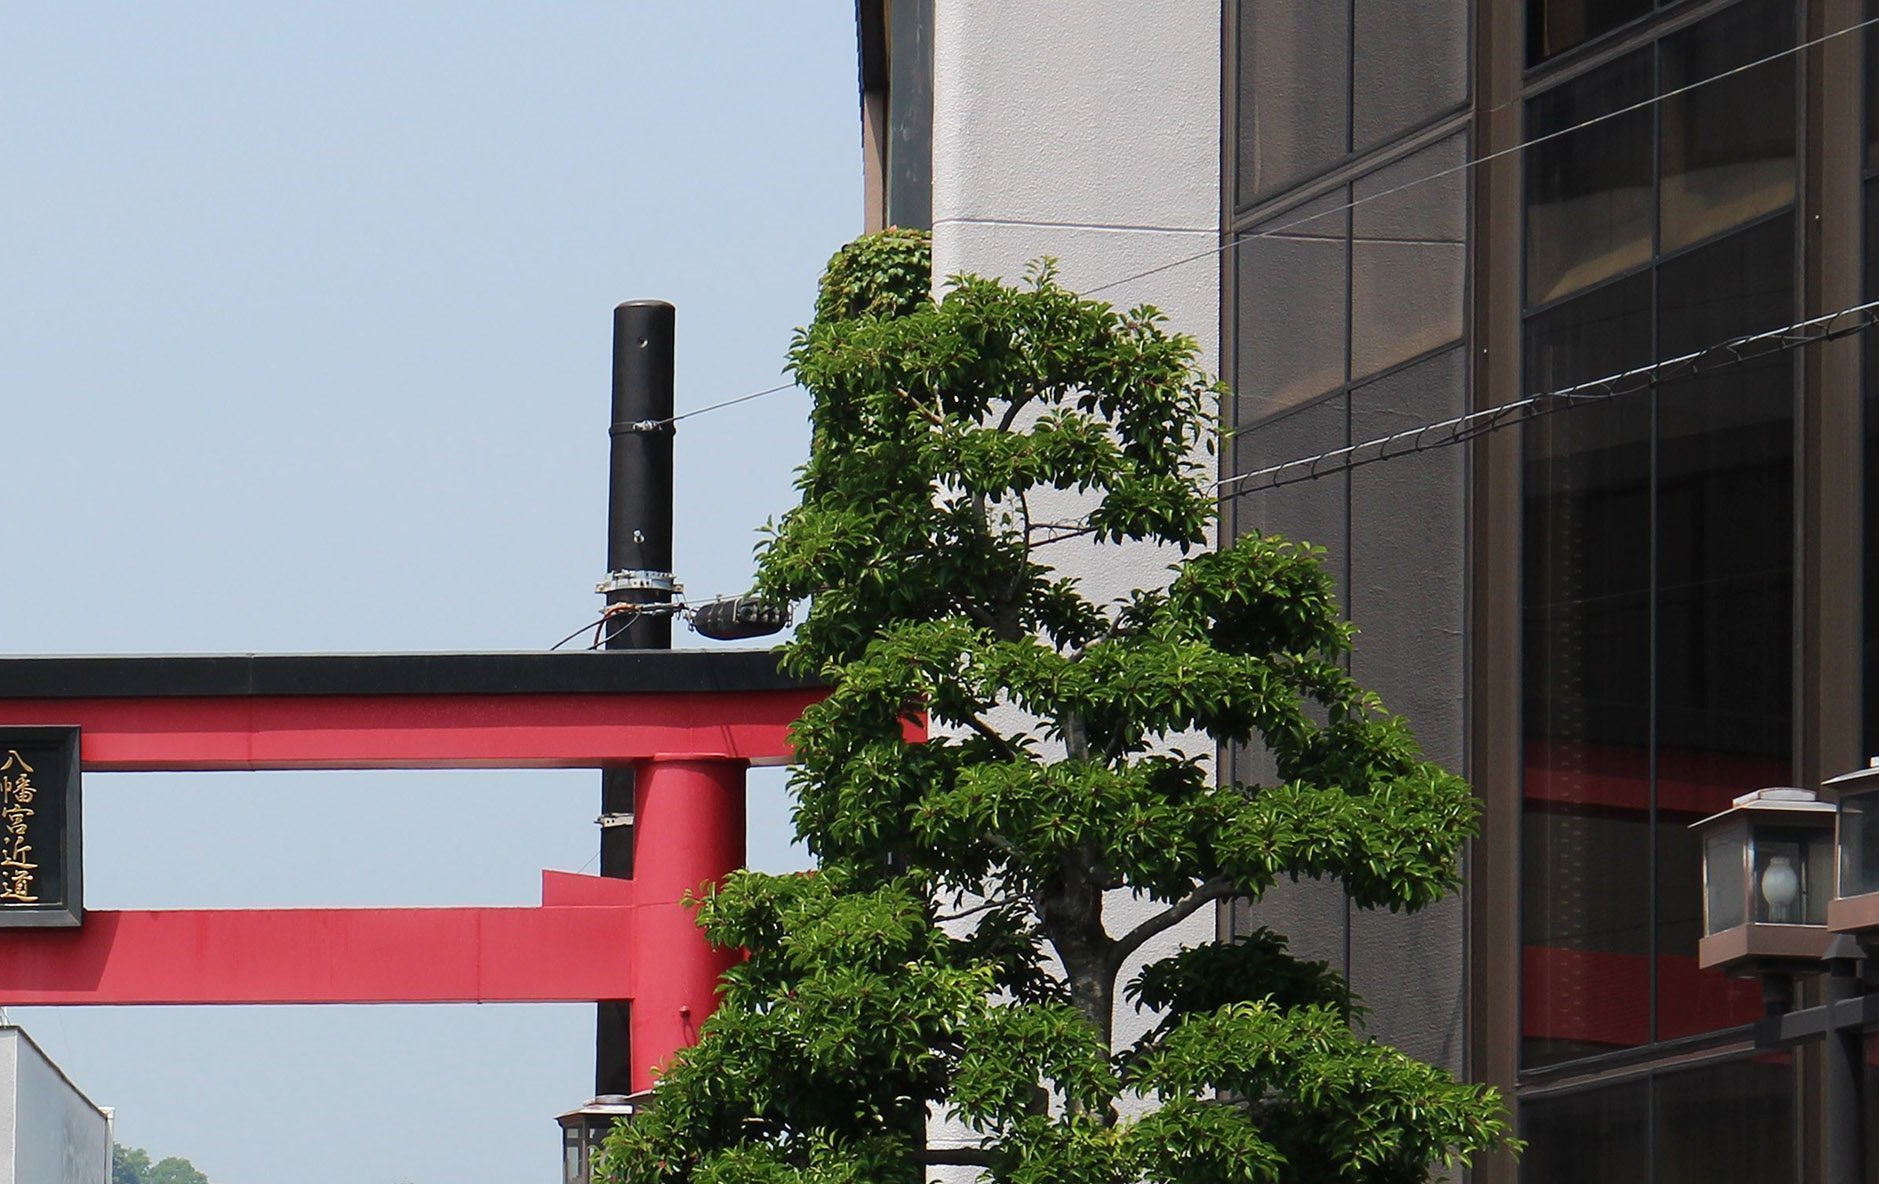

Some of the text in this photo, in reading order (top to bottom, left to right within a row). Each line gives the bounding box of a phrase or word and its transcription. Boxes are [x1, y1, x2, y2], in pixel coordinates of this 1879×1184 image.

[0, 750, 38, 902] 八幡宮近道
